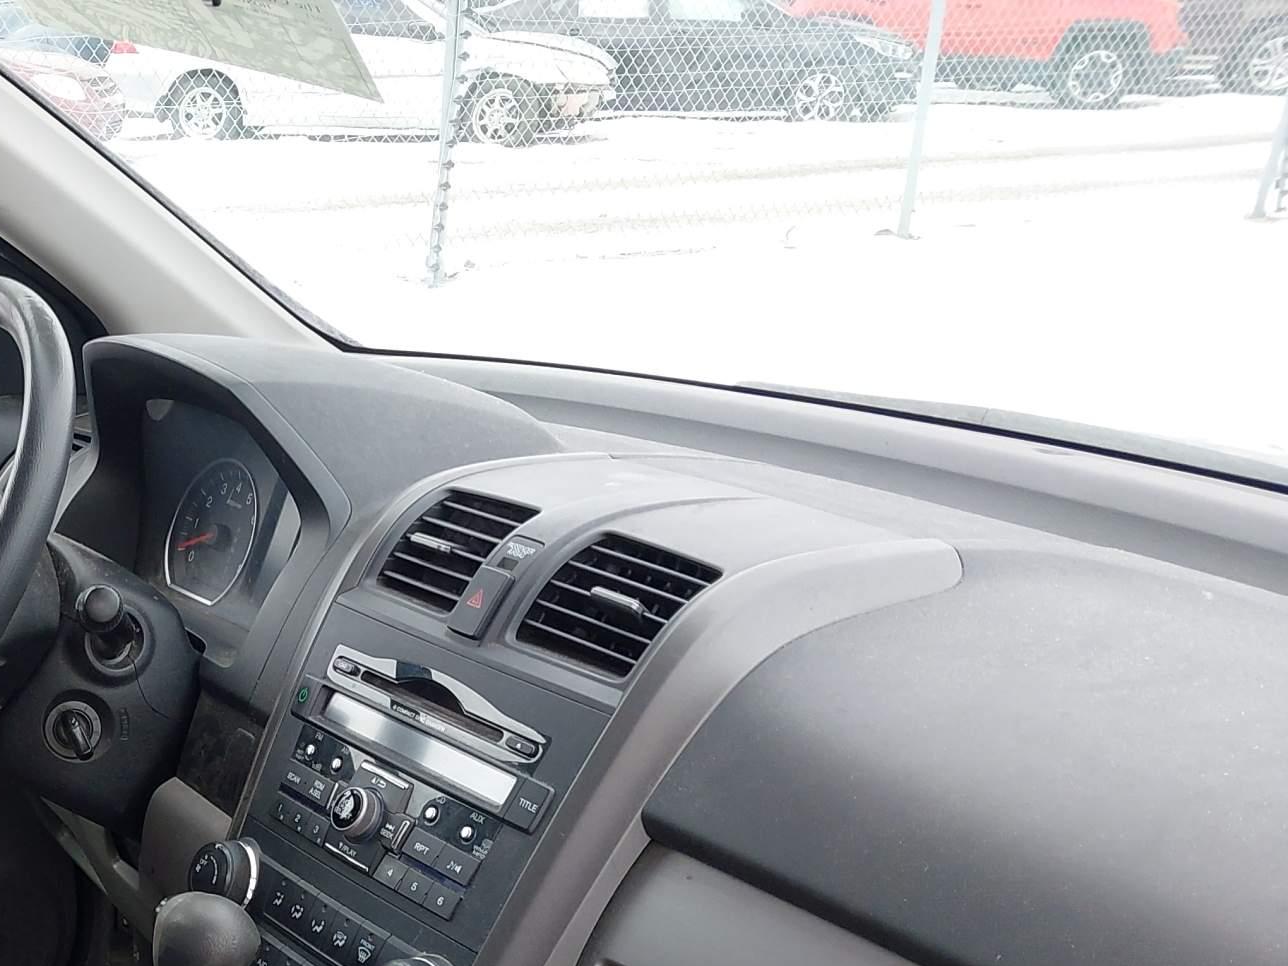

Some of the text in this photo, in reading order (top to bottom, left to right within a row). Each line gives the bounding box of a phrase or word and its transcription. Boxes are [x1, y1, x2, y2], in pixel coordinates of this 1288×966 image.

[220, 483, 228, 495] 3
[236, 483, 242, 494] 4
[205, 496, 213, 508] 2
[246, 493, 253, 505] 5
[194, 518, 200, 529] 1
[188, 550, 195, 562] 0
[519, 797, 540, 814] TITLE
[294, 814, 301, 823] 2
[470, 811, 485, 825] AUX
[313, 825, 320, 834] 3
[413, 842, 430, 855] RPT
[387, 868, 393, 877] 4
[411, 882, 418, 891] 5
[437, 896, 444, 905] 6
